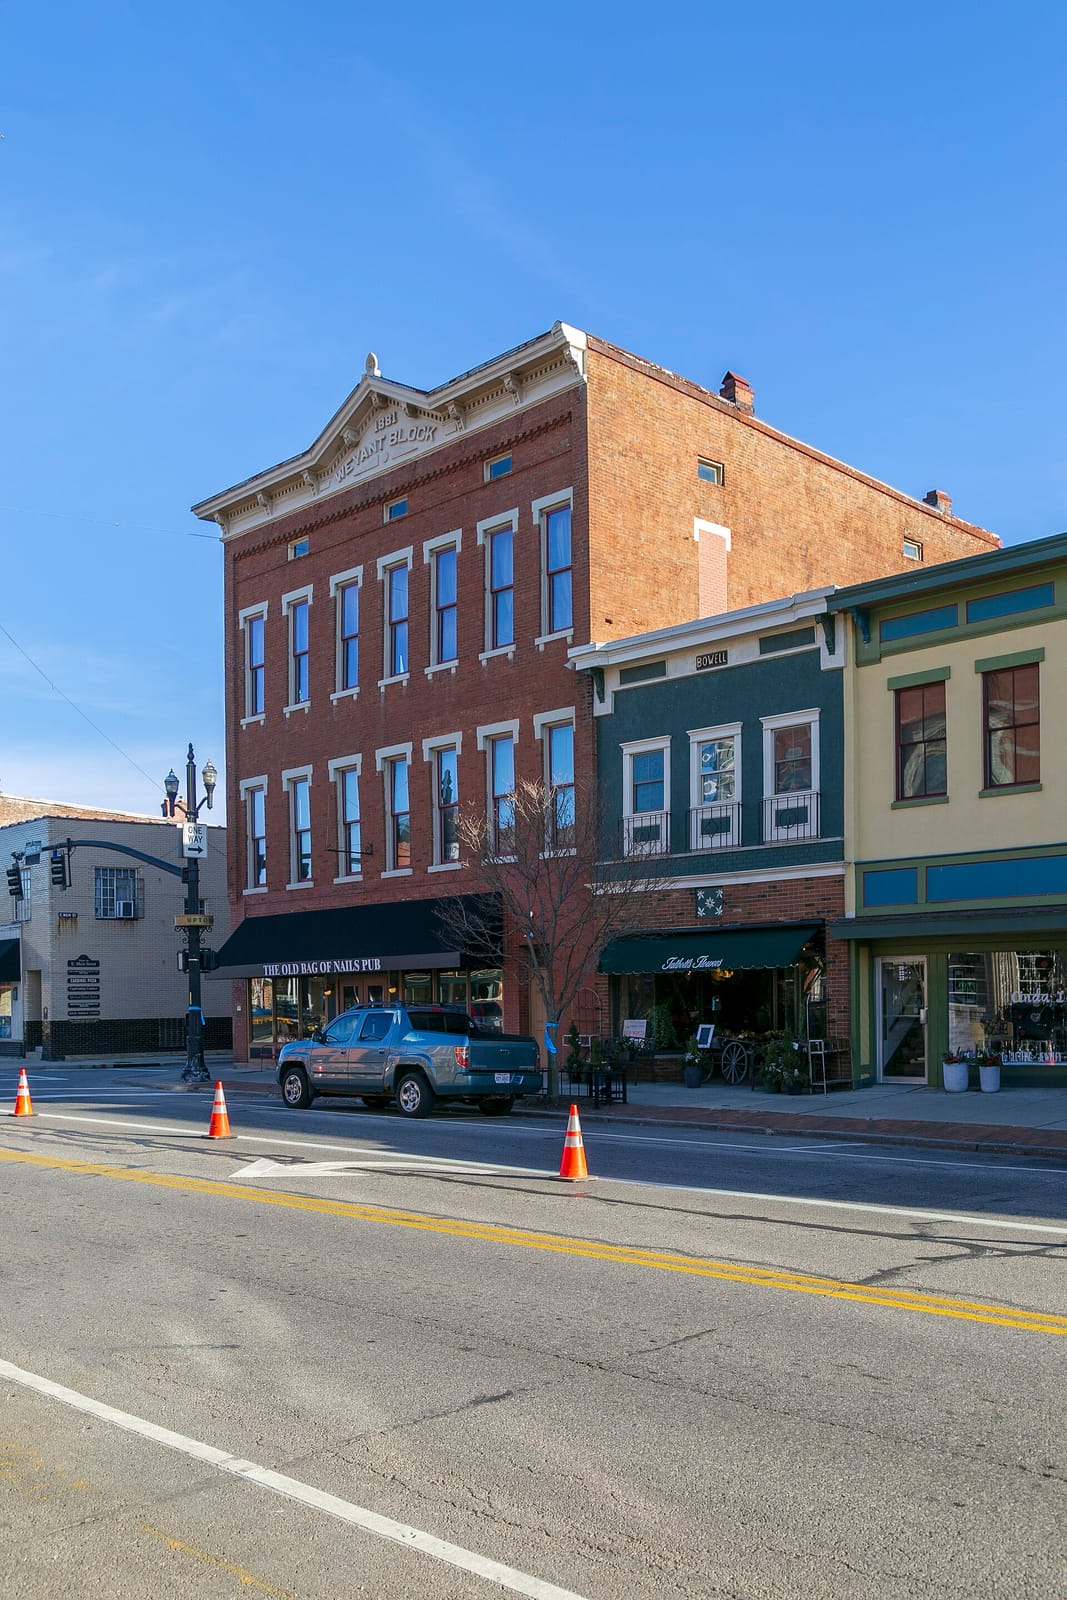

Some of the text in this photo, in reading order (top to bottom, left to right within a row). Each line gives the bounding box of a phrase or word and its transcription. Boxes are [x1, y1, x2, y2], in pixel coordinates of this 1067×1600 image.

[375, 411, 397, 432] 1881
[335, 426, 438, 483] WEYANT BLOCK
[188, 825, 203, 835] ONE
[188, 834, 203, 844] WAY
[263, 958, 381, 976] THE OLD BAG OF NAILS PUB
